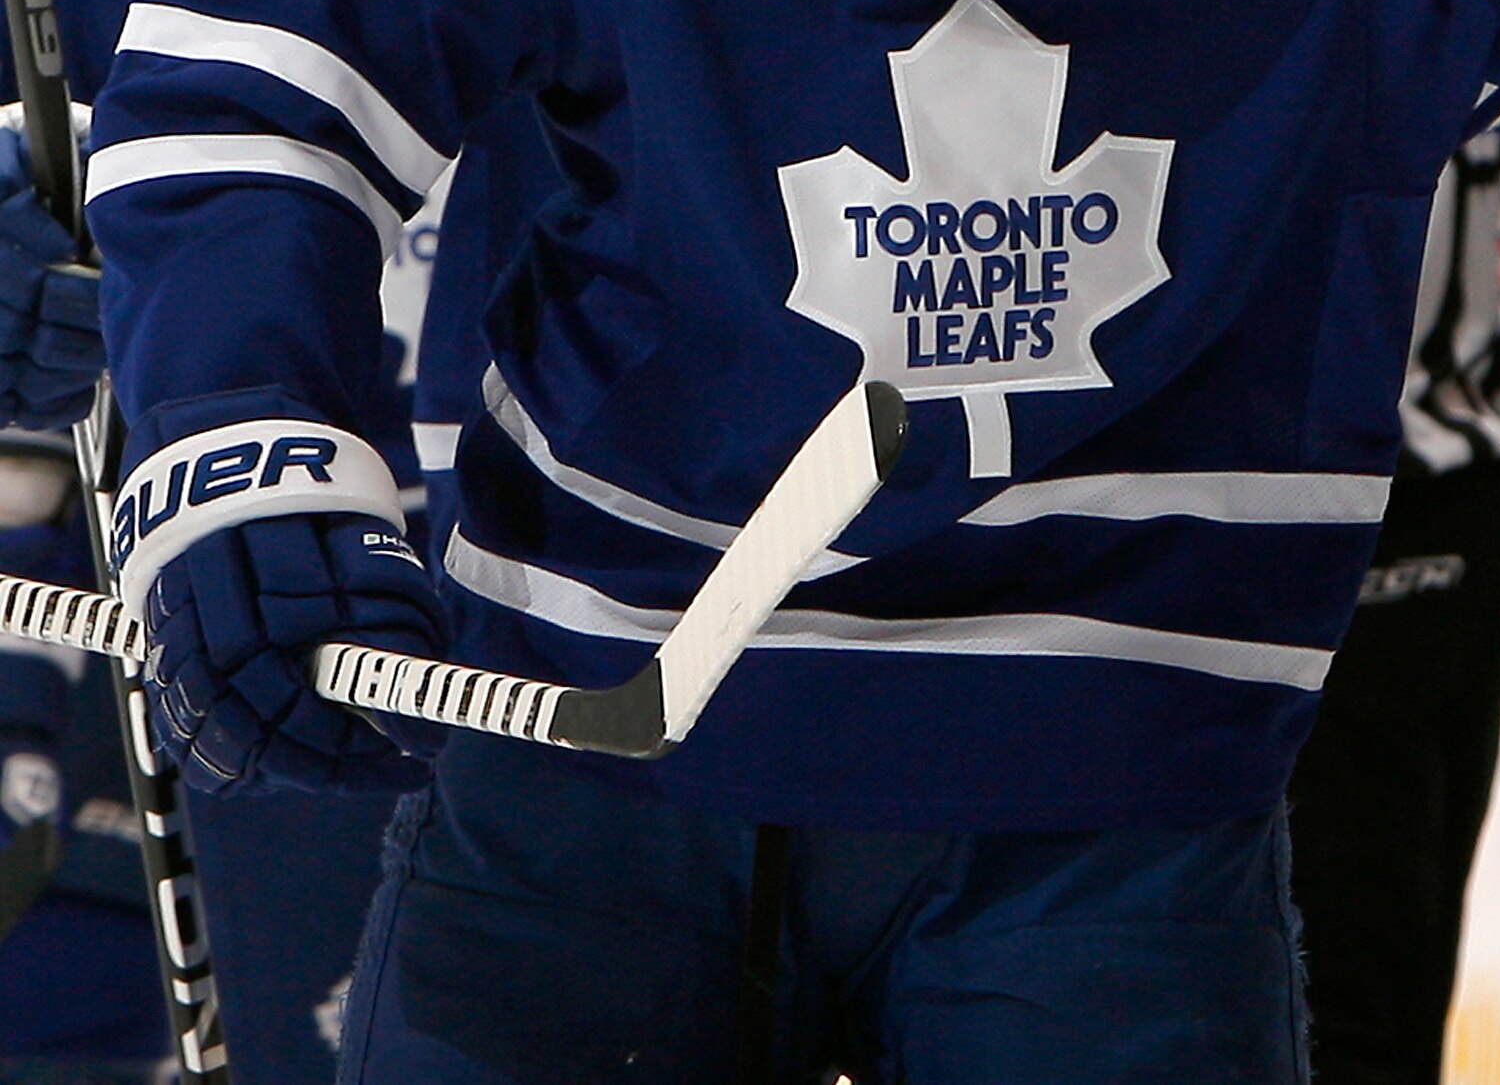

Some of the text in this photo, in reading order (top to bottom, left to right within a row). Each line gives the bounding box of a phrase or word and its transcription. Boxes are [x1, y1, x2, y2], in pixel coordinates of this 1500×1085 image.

[844, 192, 1118, 258] TORONTO
[893, 250, 1070, 313] MAPLE
[907, 307, 1056, 368] LEAFS
[109, 436, 338, 566] AUER
